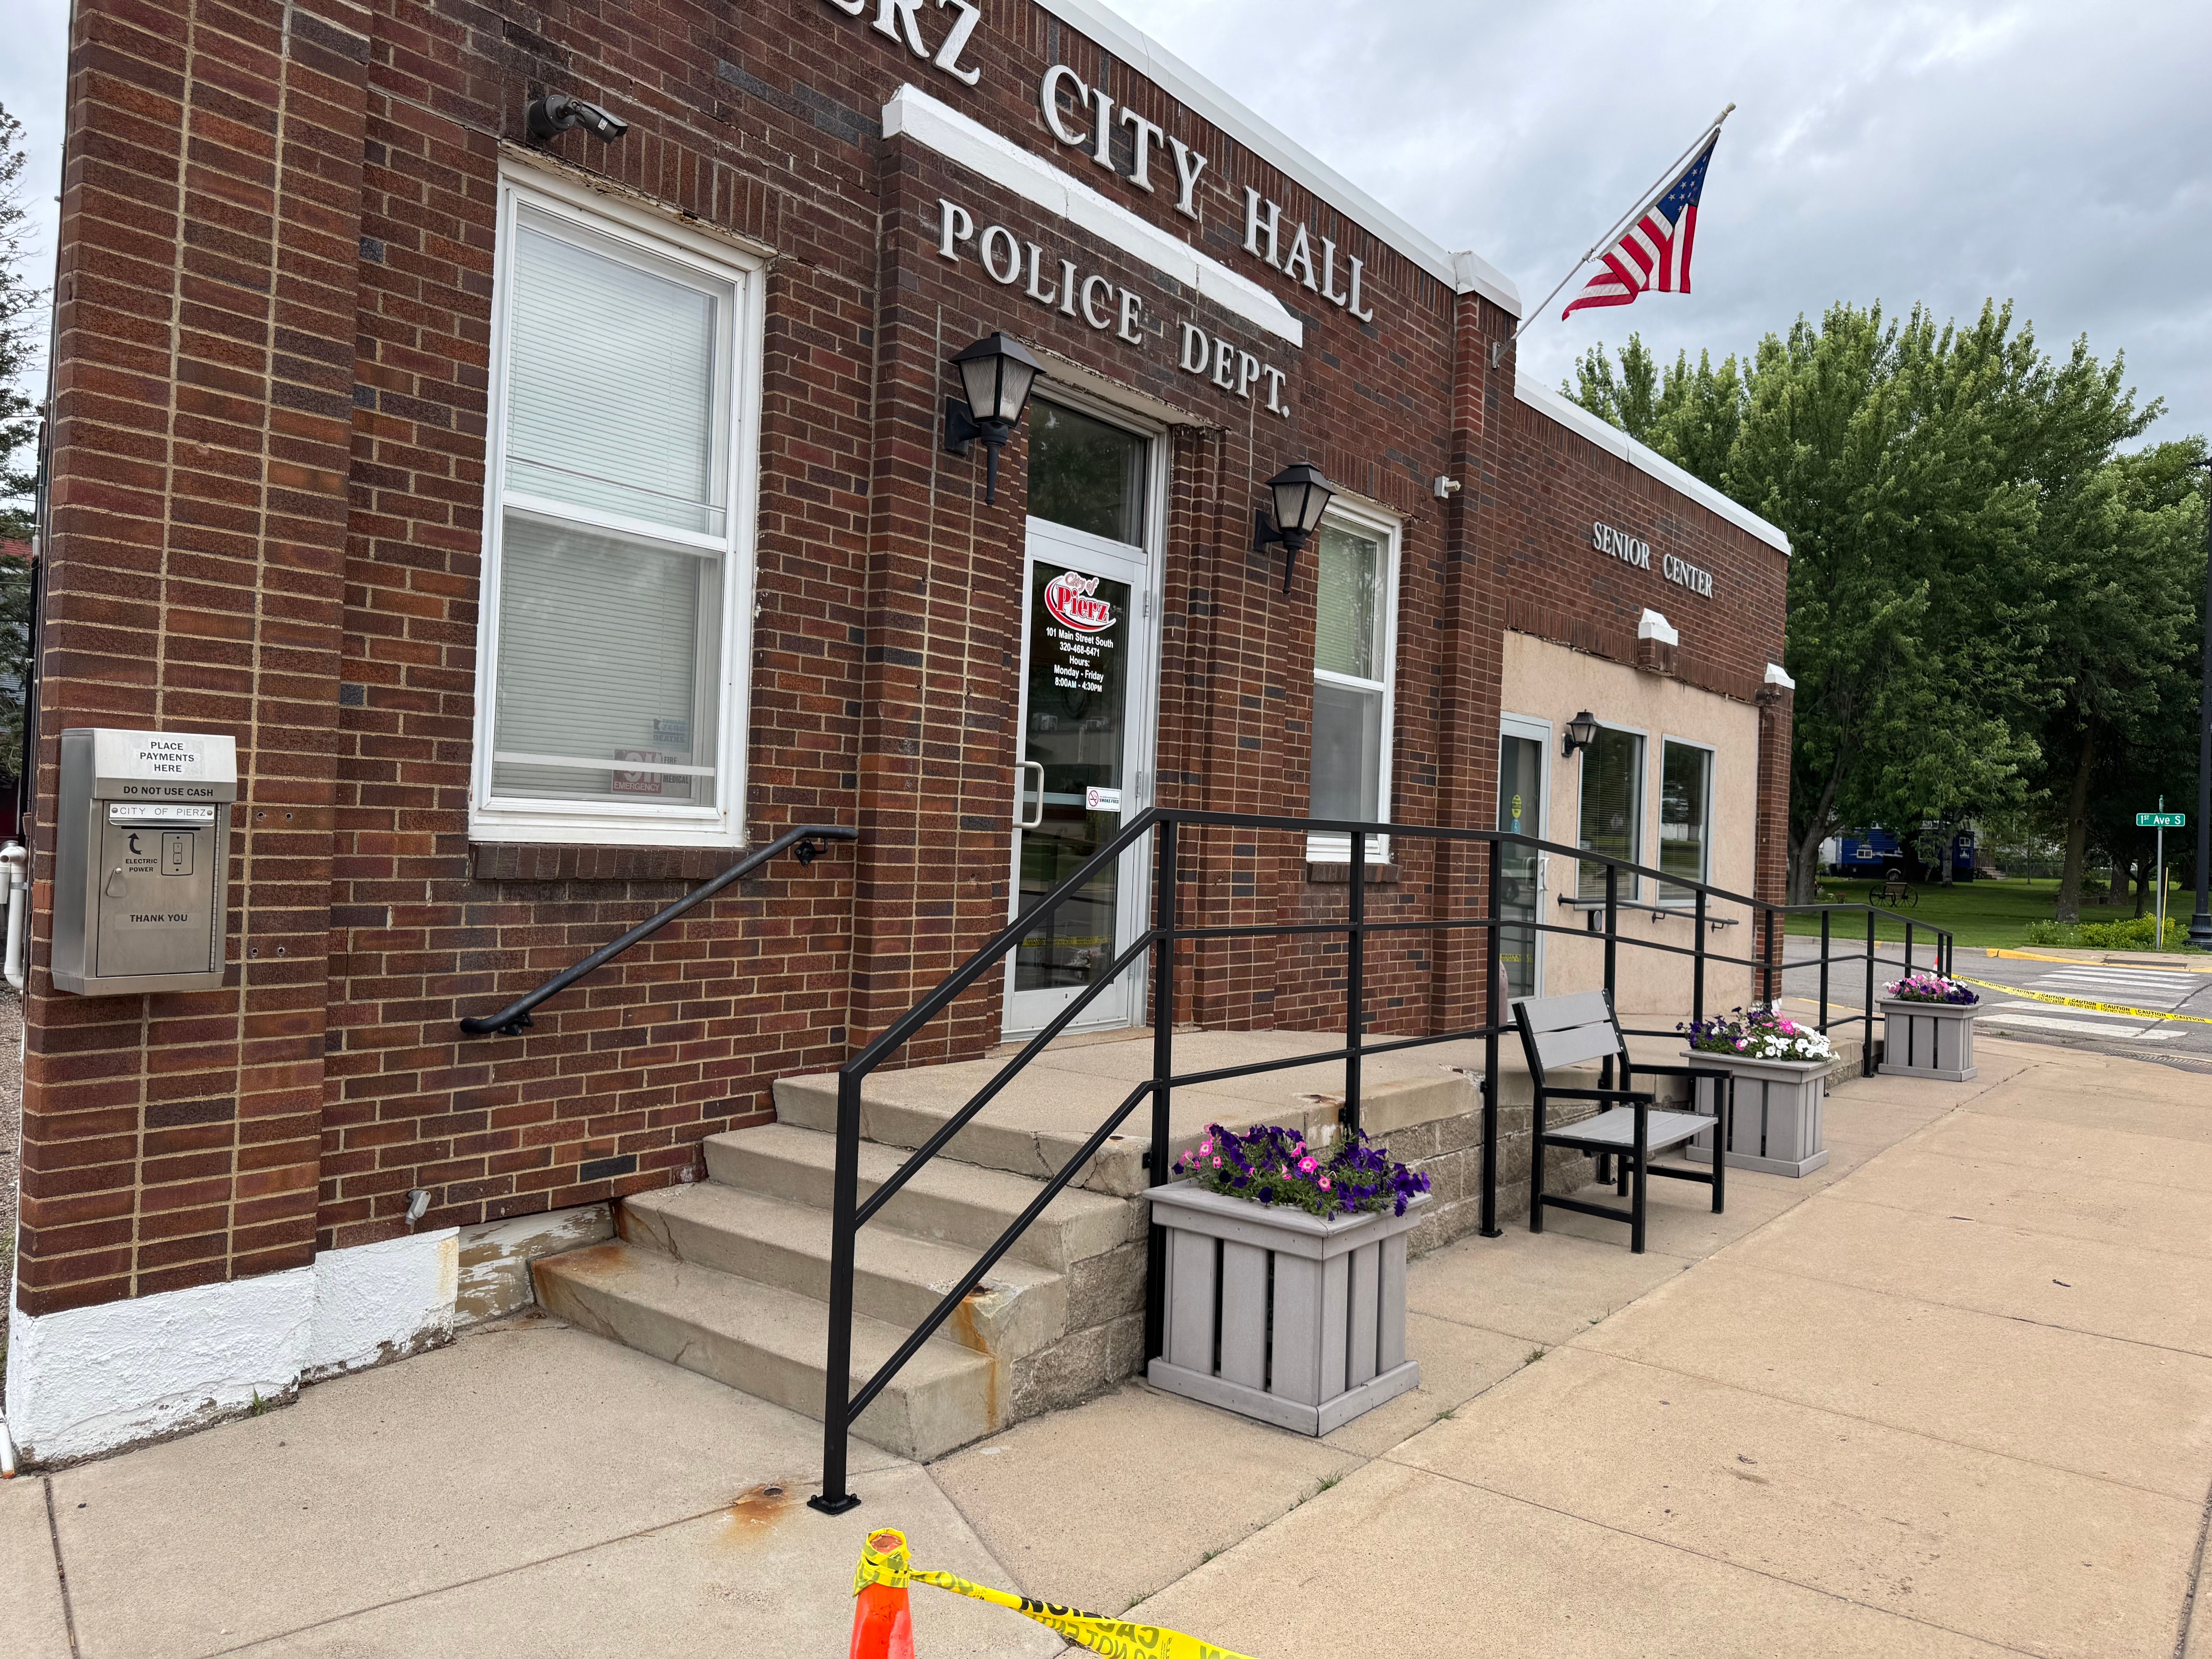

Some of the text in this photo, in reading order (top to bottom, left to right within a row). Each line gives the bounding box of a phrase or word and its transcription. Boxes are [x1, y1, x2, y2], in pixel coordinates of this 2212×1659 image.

[827, 0, 1373, 323] RZ CITY HALL
[937, 198, 1290, 418] POLICE DEPT.
[1592, 522, 1712, 599] SENIOR CENTER
[1065, 573, 1098, 594] City of
[1055, 584, 1108, 623] Pierz
[1046, 627, 1114, 648] 101 Main Street South
[1060, 641, 1100, 657] 320-468-6471
[1069, 655, 1090, 667] Hours:
[1054, 664, 1079, 679] Monday
[1085, 669, 1104, 683] Friday
[1055, 677, 1077, 689] 8:00AM
[1082, 681, 1102, 692] 4:30PM
[653, 735, 685, 743] DEATHS
[151, 741, 184, 751] PLACE
[140, 752, 194, 762] PAYMENTS
[664, 756, 677, 764] FIRE
[154, 764, 182, 773] HERE
[663, 775, 689, 784] MEDICAL
[123, 786, 213, 797] DO NOT USE CASH
[614, 781, 661, 792] EMERGENCY
[120, 807, 206, 816] CITY OF PIERZ
[2140, 815, 2181, 824] 1ST Ave S
[130, 914, 188, 922] THANK YOU
